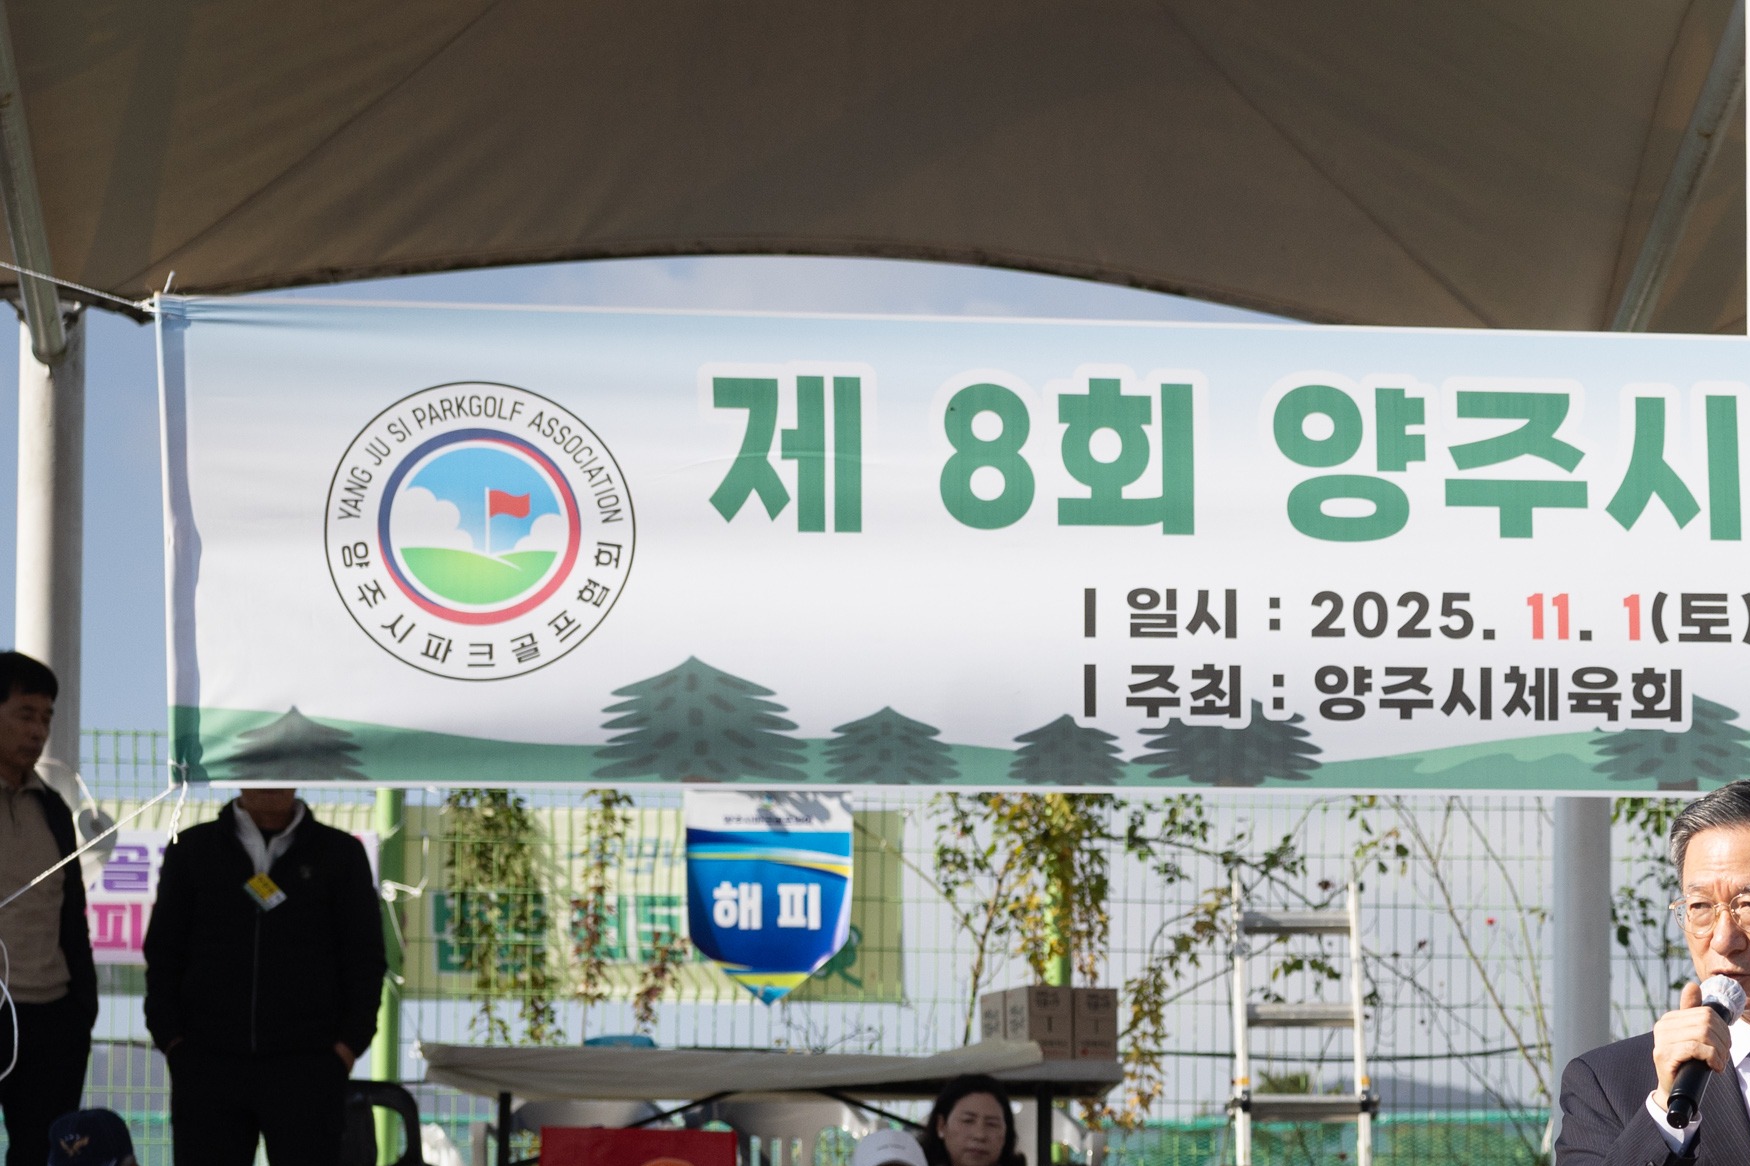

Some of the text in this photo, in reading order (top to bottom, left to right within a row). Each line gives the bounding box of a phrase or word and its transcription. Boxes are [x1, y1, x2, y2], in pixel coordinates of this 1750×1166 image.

[337, 395, 624, 524] YANG JU SI PARKGOLF ASSOCIATION
[709, 376, 862, 533] 제
[940, 378, 1195, 535] 8회
[1126, 587, 1237, 639] 일시
[1311, 591, 1496, 640] 2025.
[1126, 664, 1242, 719] 주최
[1315, 665, 1683, 722] 양주시체육회
[712, 880, 822, 931] 해피
